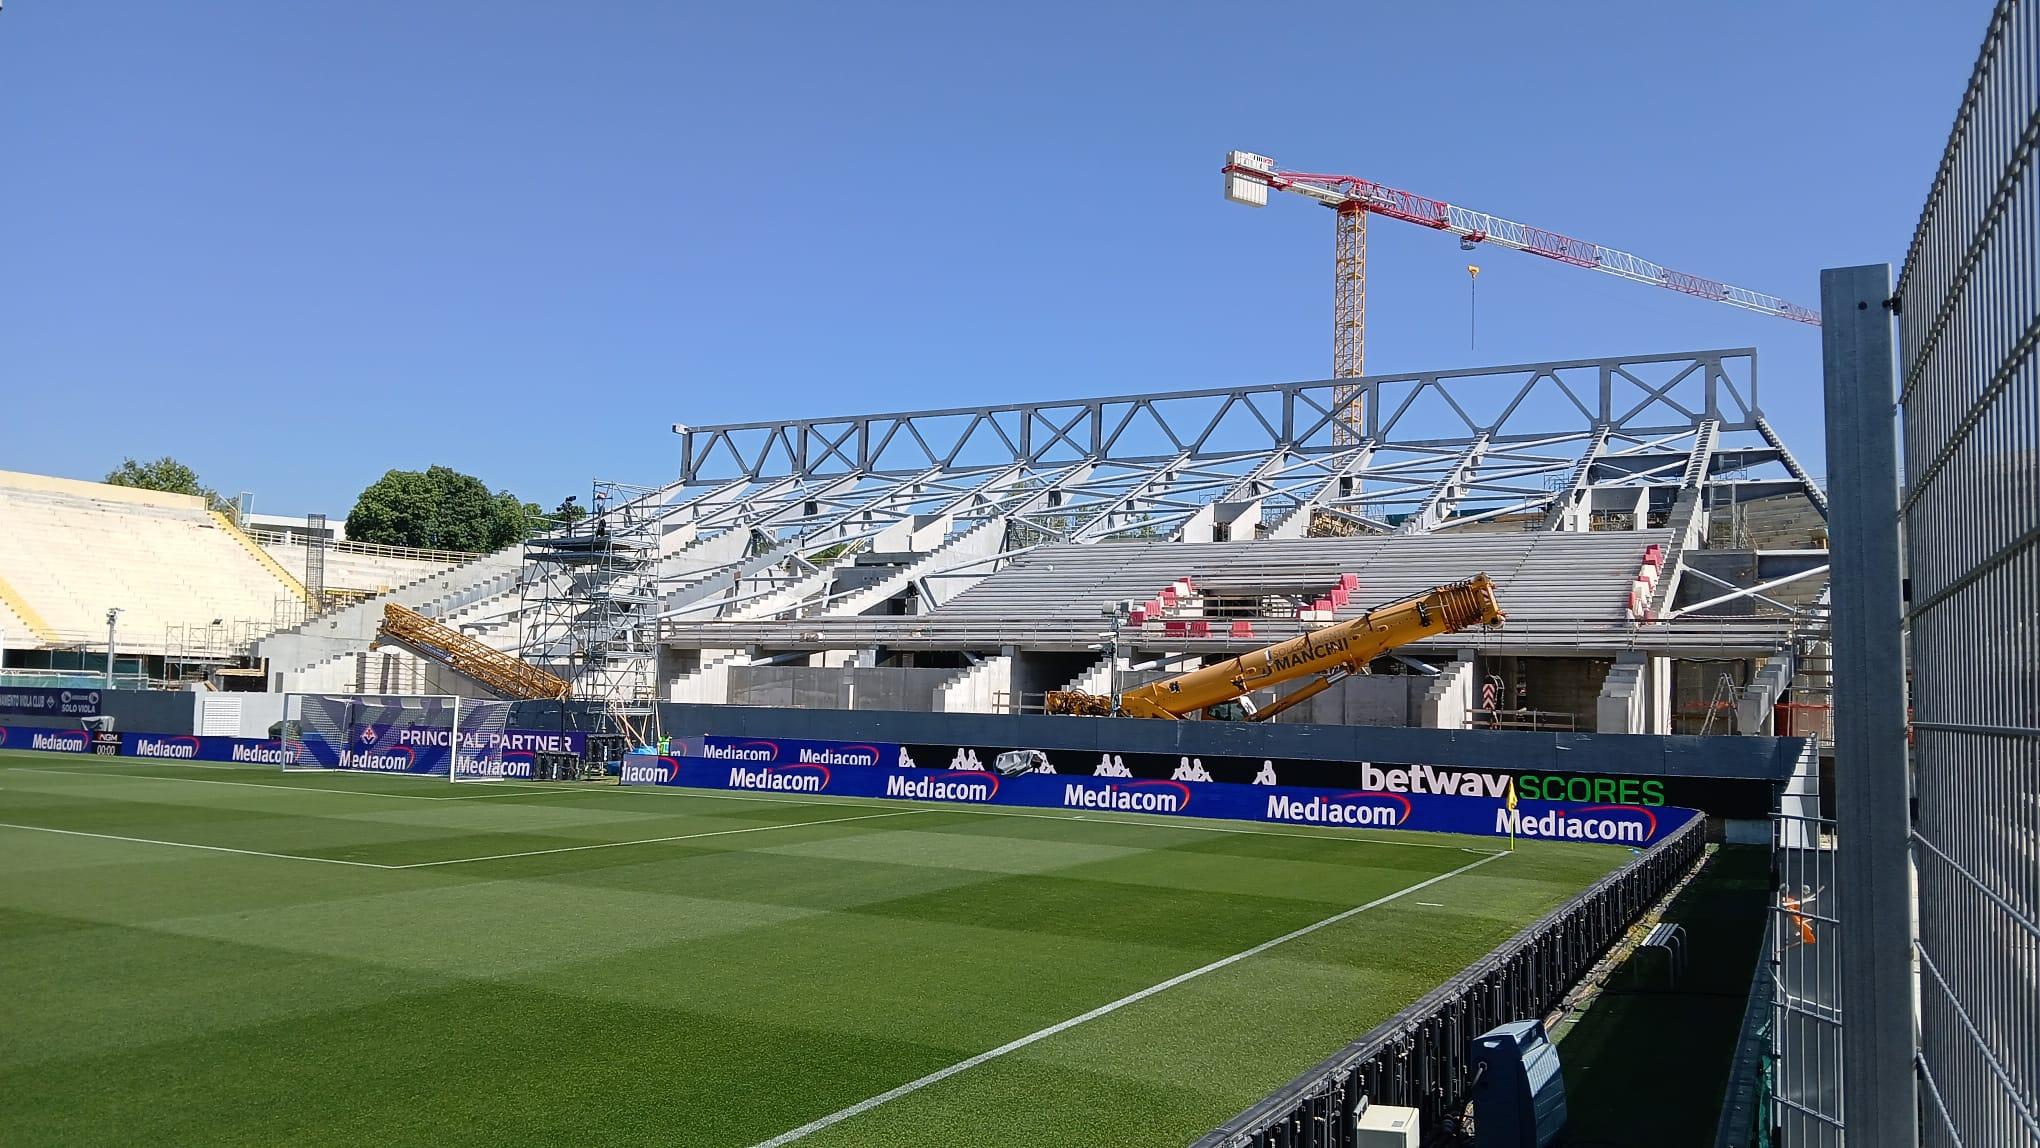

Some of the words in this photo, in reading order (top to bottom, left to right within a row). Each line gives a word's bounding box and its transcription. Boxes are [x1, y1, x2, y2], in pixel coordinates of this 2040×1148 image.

[1273, 637, 1349, 671] MANCINI
[62, 704, 77, 713] SOLO
[78, 705, 96, 713] VIOLA
[32, 734, 82, 751] Mediacom
[137, 740, 192, 758] Mediacom
[400, 729, 486, 748] PRINCIPAL
[490, 732, 571, 752] PARTNER
[232, 744, 294, 764] Mediacom
[339, 750, 406, 770] Mediacom
[704, 745, 770, 761] Mediacom
[800, 749, 872, 765] Mediacom
[457, 756, 530, 777] Mediacom
[729, 767, 819, 791] Mediacom
[887, 775, 987, 801] Mediacom
[1064, 784, 1177, 812] Mediacom
[1519, 775, 1664, 806] SCORES
[1267, 795, 1397, 826] Mediacom
[1496, 808, 1644, 841] Mediacom
